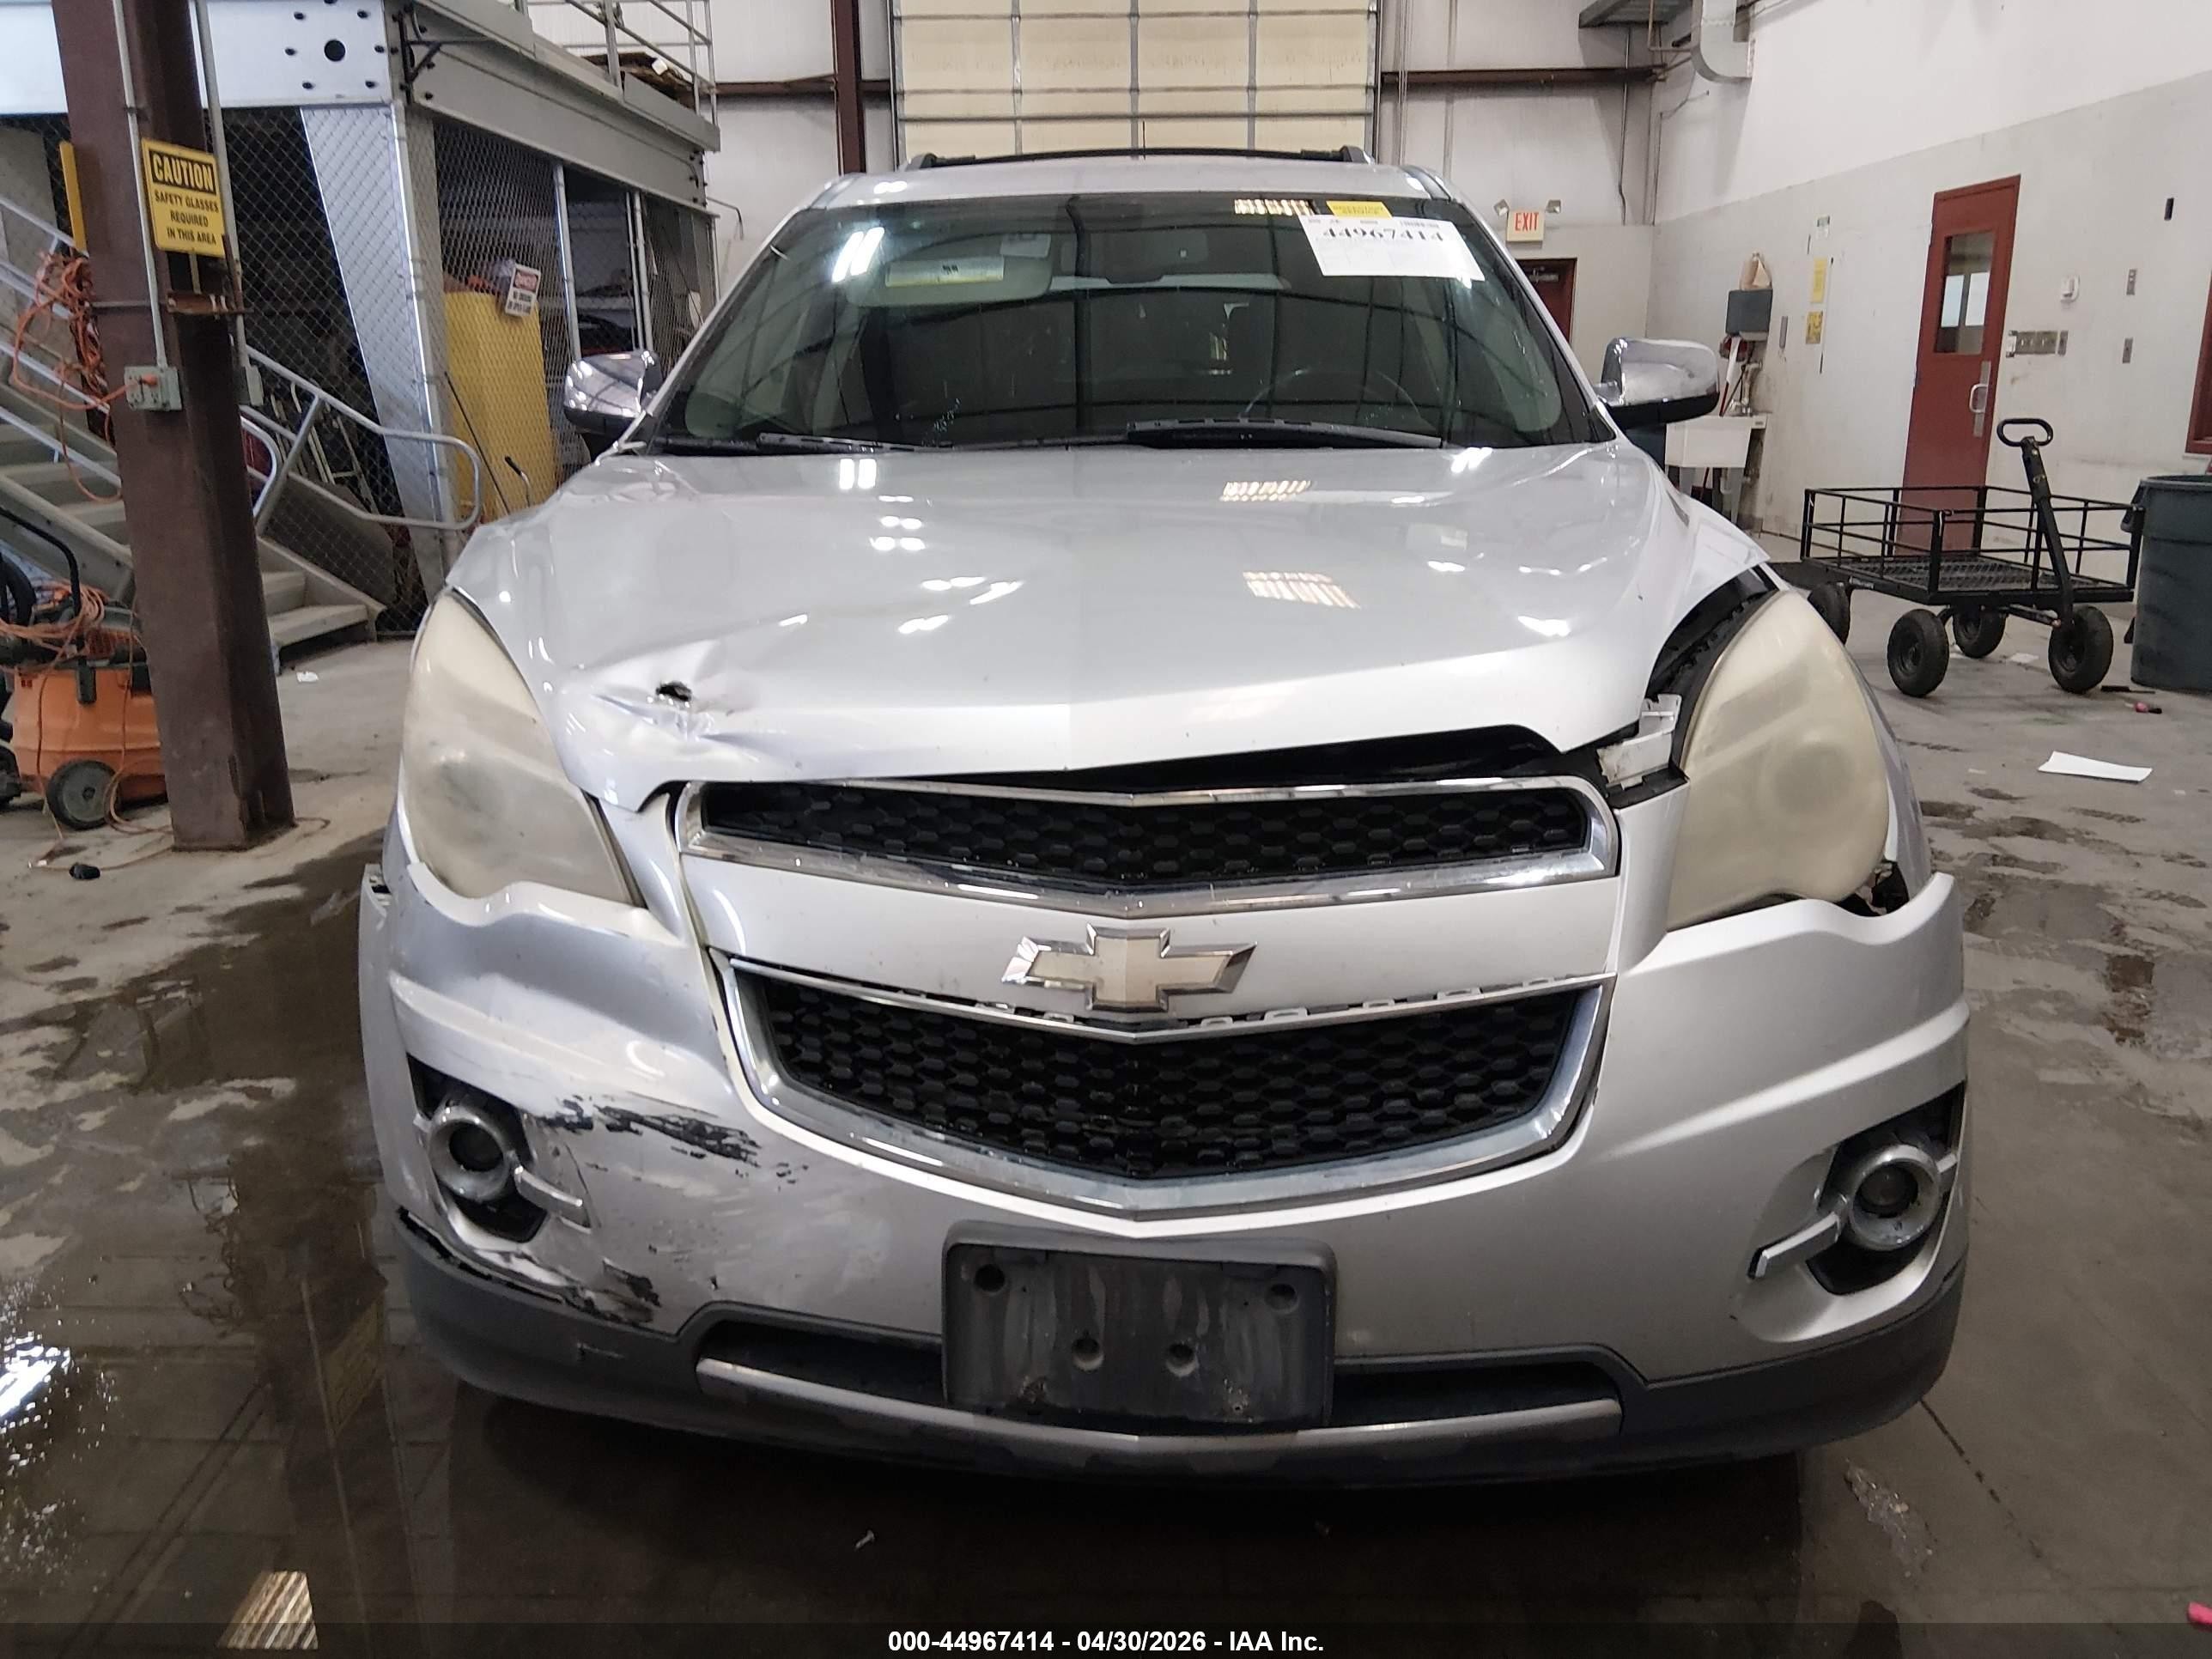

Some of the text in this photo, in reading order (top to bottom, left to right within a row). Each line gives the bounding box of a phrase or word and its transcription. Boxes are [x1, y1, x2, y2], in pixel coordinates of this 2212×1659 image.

[152, 154, 215, 192] CAUTION
[155, 189, 219, 213] SAFETY GLASSES
[170, 210, 209, 228] REQUIRED
[1515, 211, 1540, 232] EXIT
[167, 227, 216, 246] IN THIS AREA
[1323, 227, 1444, 241] 44967414
